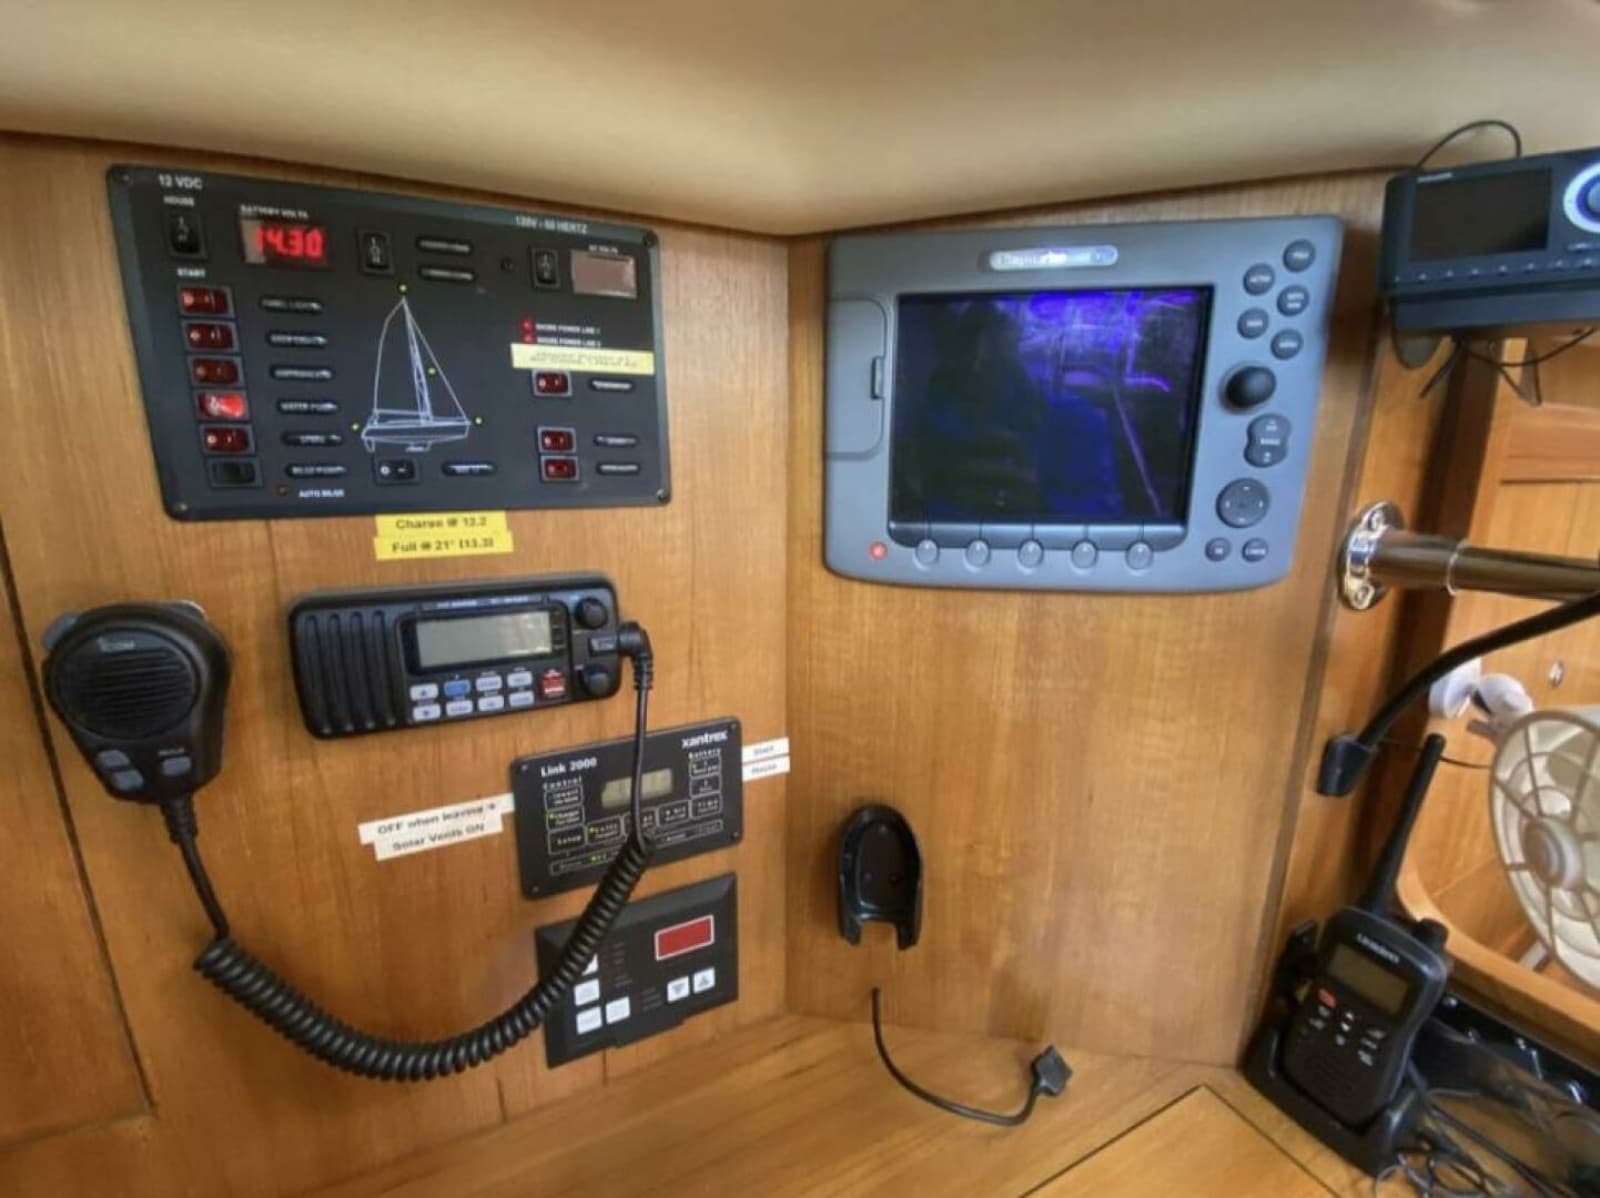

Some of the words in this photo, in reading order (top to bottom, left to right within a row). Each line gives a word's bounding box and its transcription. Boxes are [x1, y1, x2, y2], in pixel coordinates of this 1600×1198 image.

[175, 175, 203, 190] VDC
[391, 541, 417, 553] Full
[682, 730, 728, 749] xantrex
[540, 762, 567, 778] Link
[569, 757, 597, 772] 2000
